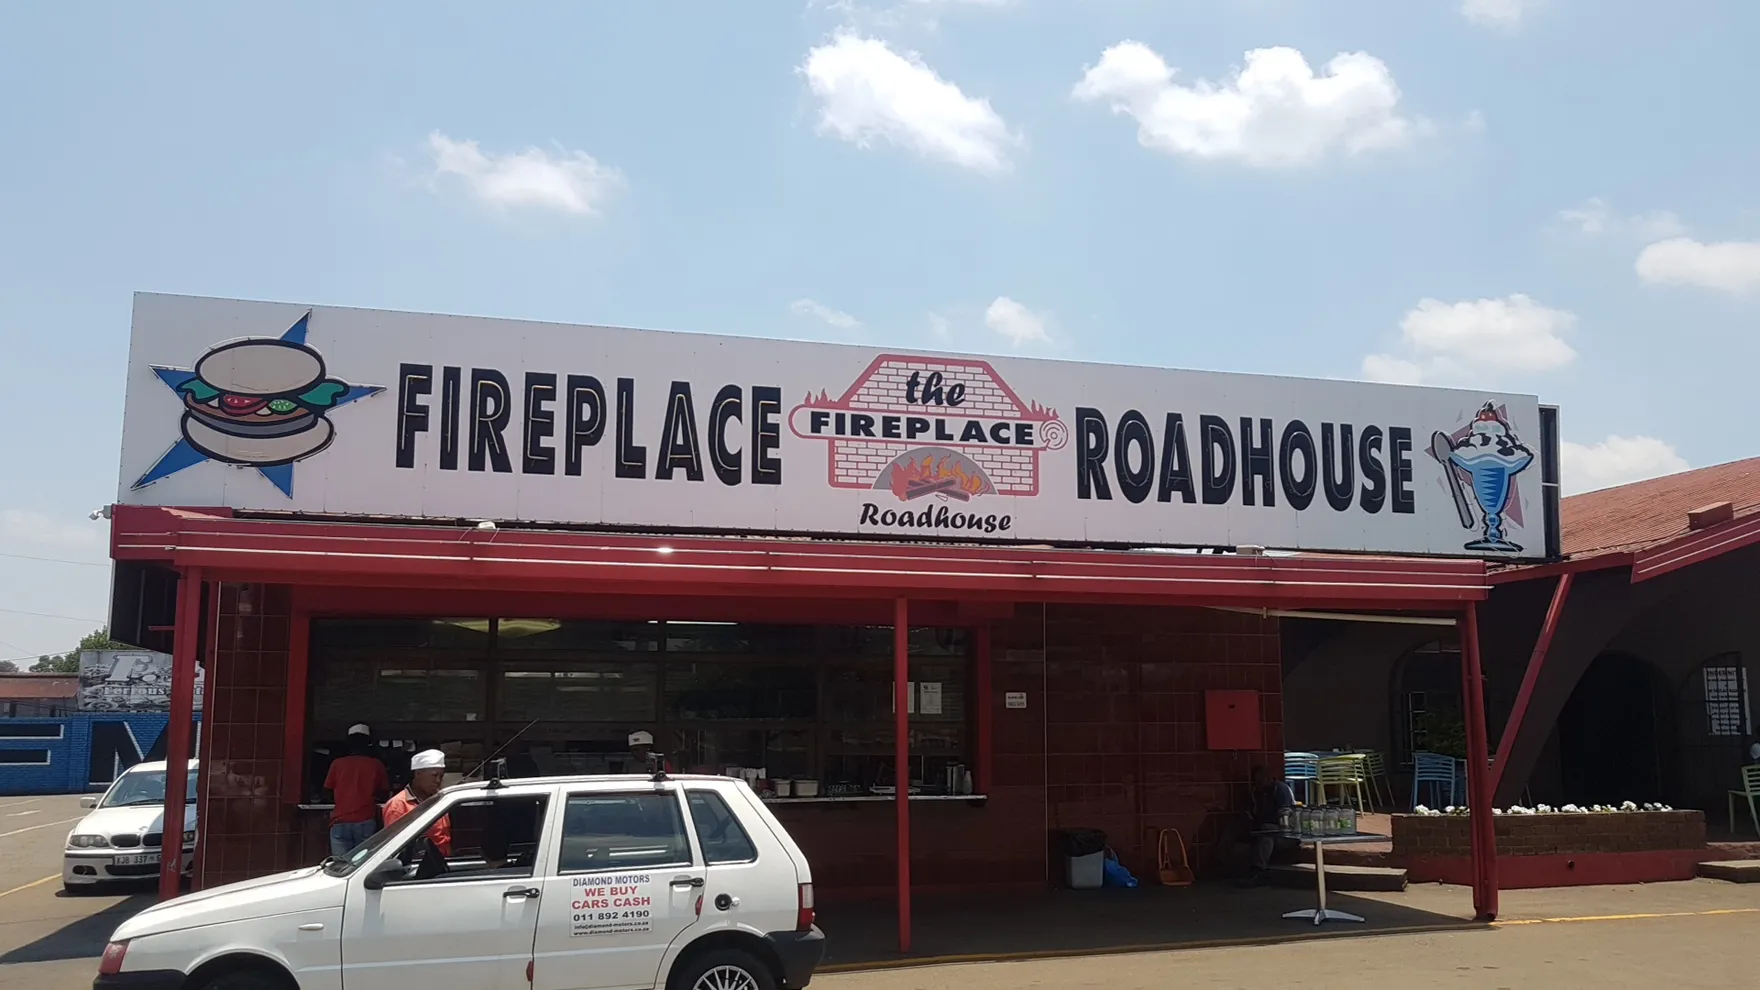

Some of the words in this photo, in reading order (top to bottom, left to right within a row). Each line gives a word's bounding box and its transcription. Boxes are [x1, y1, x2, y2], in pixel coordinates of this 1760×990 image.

[905, 370, 966, 407] the
[395, 363, 783, 487] FIREPLACE
[810, 411, 1034, 445] FIREPLACE
[1075, 406, 1416, 514] ROADHOUSE
[859, 503, 1012, 533] Roadhouse
[134, 855, 148, 864] 337
[573, 876, 612, 886] DIAMOND
[615, 875, 650, 884] MOTORS
[584, 887, 605, 897] WE
[610, 886, 638, 896] BUY
[572, 899, 608, 910] CARS
[614, 896, 650, 907] CASH
[573, 913, 593, 921] 011
[598, 912, 618, 920] 892
[622, 910, 649, 918] 4190
[573, 928, 649, 936] www.diamond-motors.co.za
[574, 922, 649, 930] info@diamond-motors.co.za
